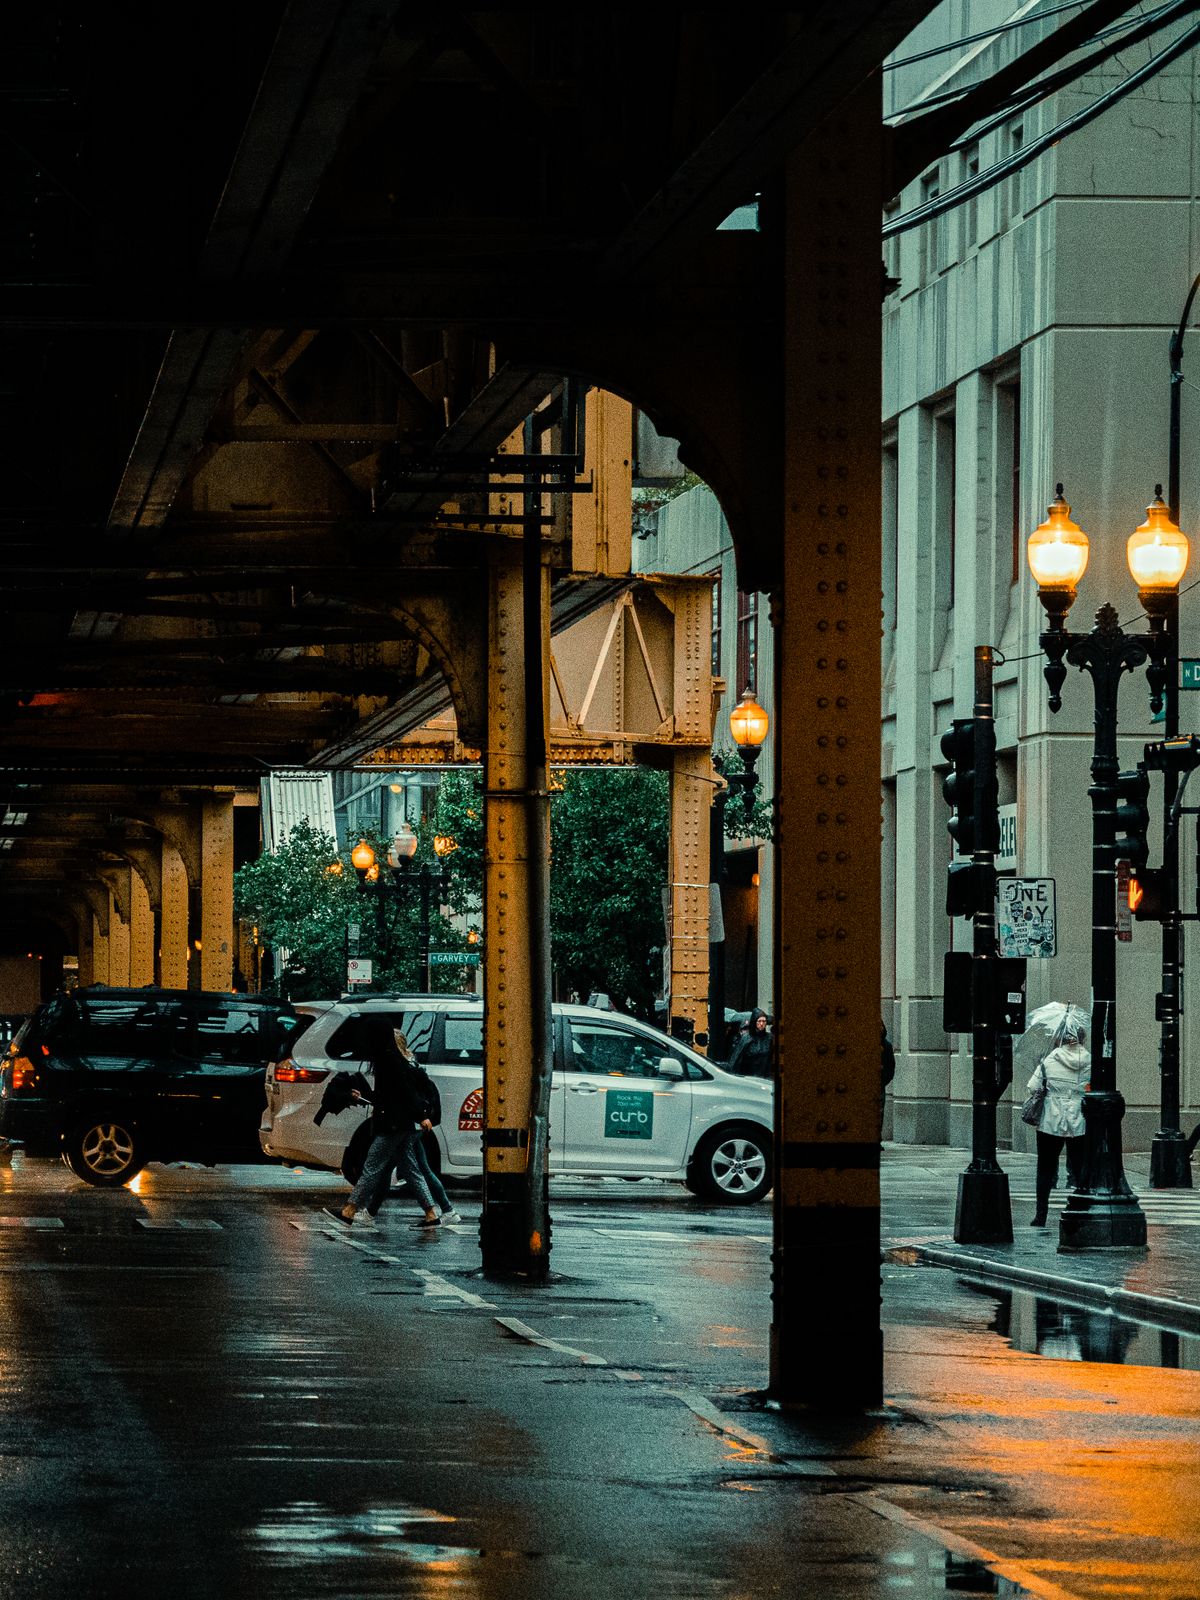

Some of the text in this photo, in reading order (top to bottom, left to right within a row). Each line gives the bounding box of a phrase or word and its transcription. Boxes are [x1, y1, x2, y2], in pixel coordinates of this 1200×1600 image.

[1006, 884, 1048, 901] ONE
[438, 954, 469, 962] GARVEY
[464, 1091, 484, 1112] CITY
[610, 1111, 648, 1123] curb
[460, 1120, 480, 1129] 773
